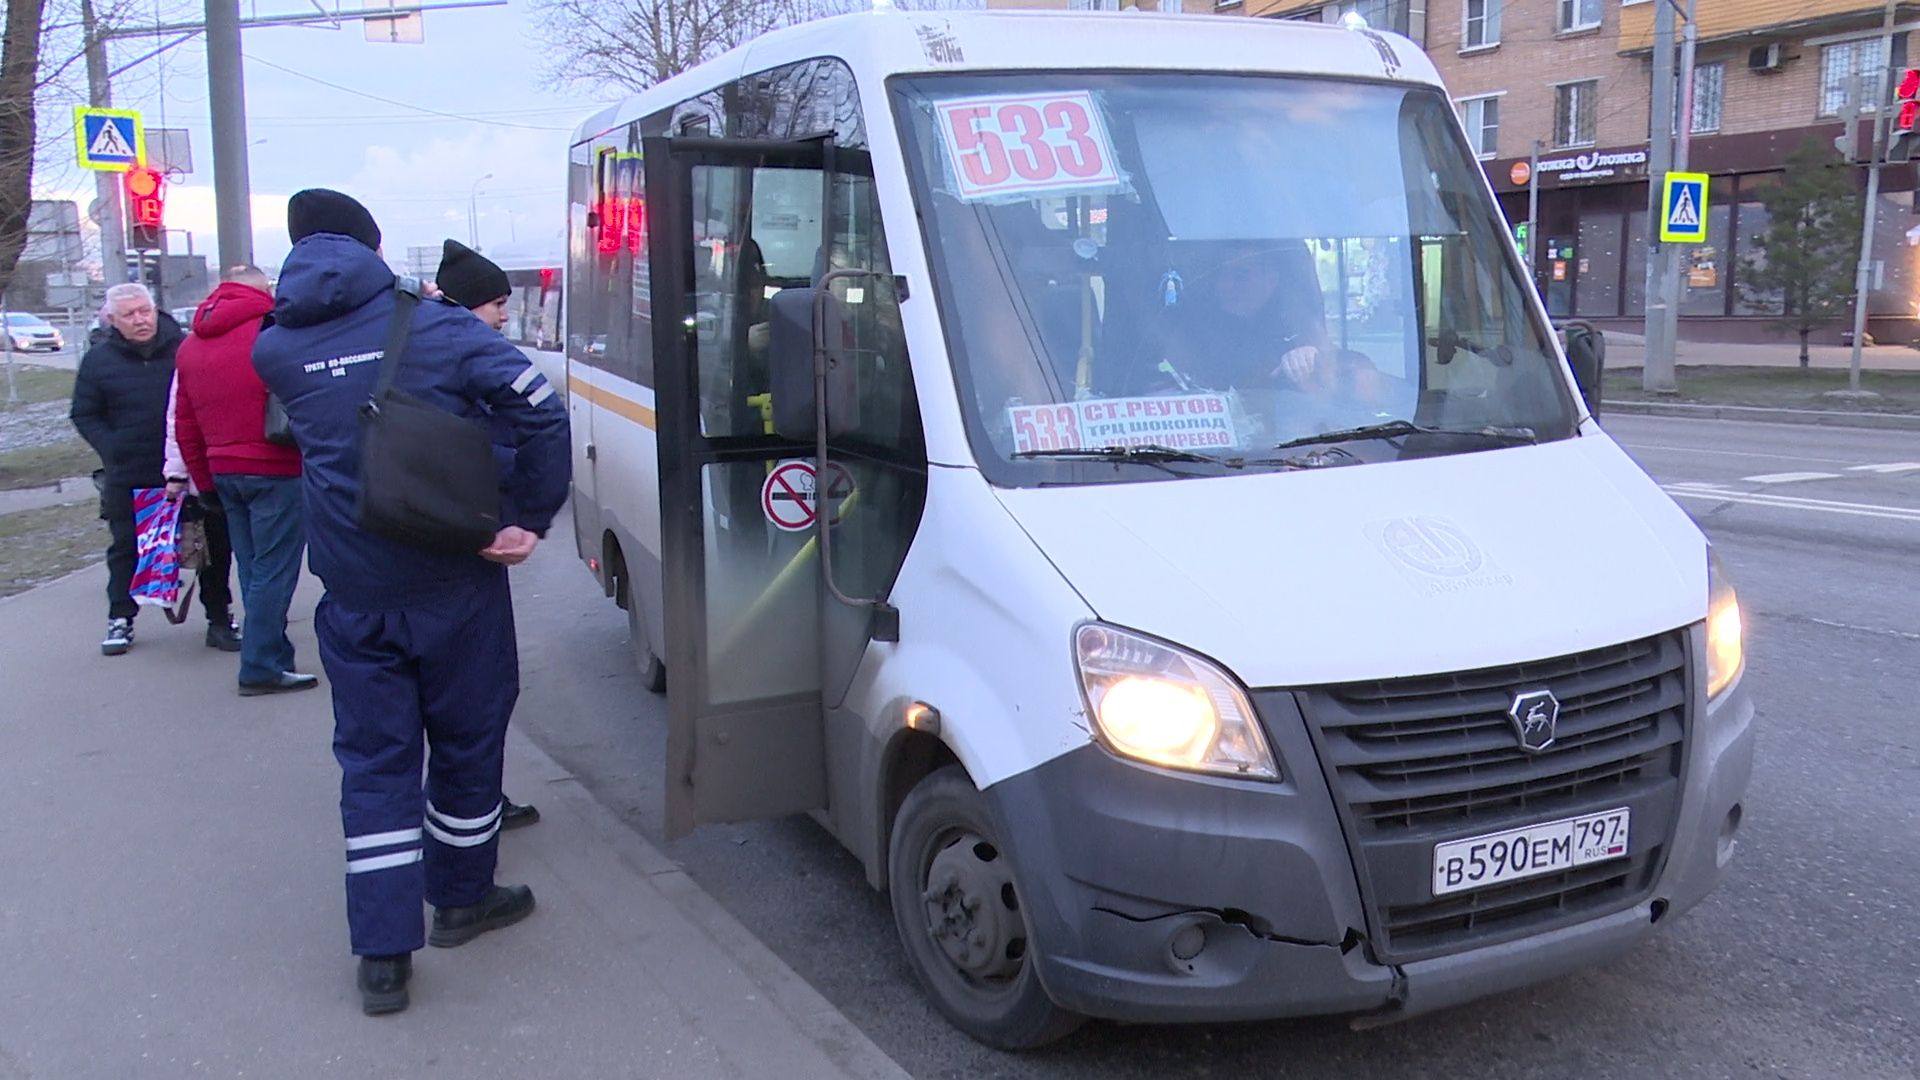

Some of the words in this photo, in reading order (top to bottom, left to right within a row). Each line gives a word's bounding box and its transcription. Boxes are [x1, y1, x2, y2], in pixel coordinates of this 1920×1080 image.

[948, 100, 1103, 186] 533
[1537, 158, 1576, 172] ожка
[1084, 399, 1224, 421] СТ.РЕУТОВ
[1013, 406, 1081, 451] 533
[1087, 421, 1126, 437] ТРЦ
[1129, 417, 1227, 433] ШОКОЛАД
[1446, 834, 1571, 886] В590ЕМ
[1576, 815, 1622, 850] 797
[1584, 846, 1607, 859] RUS
